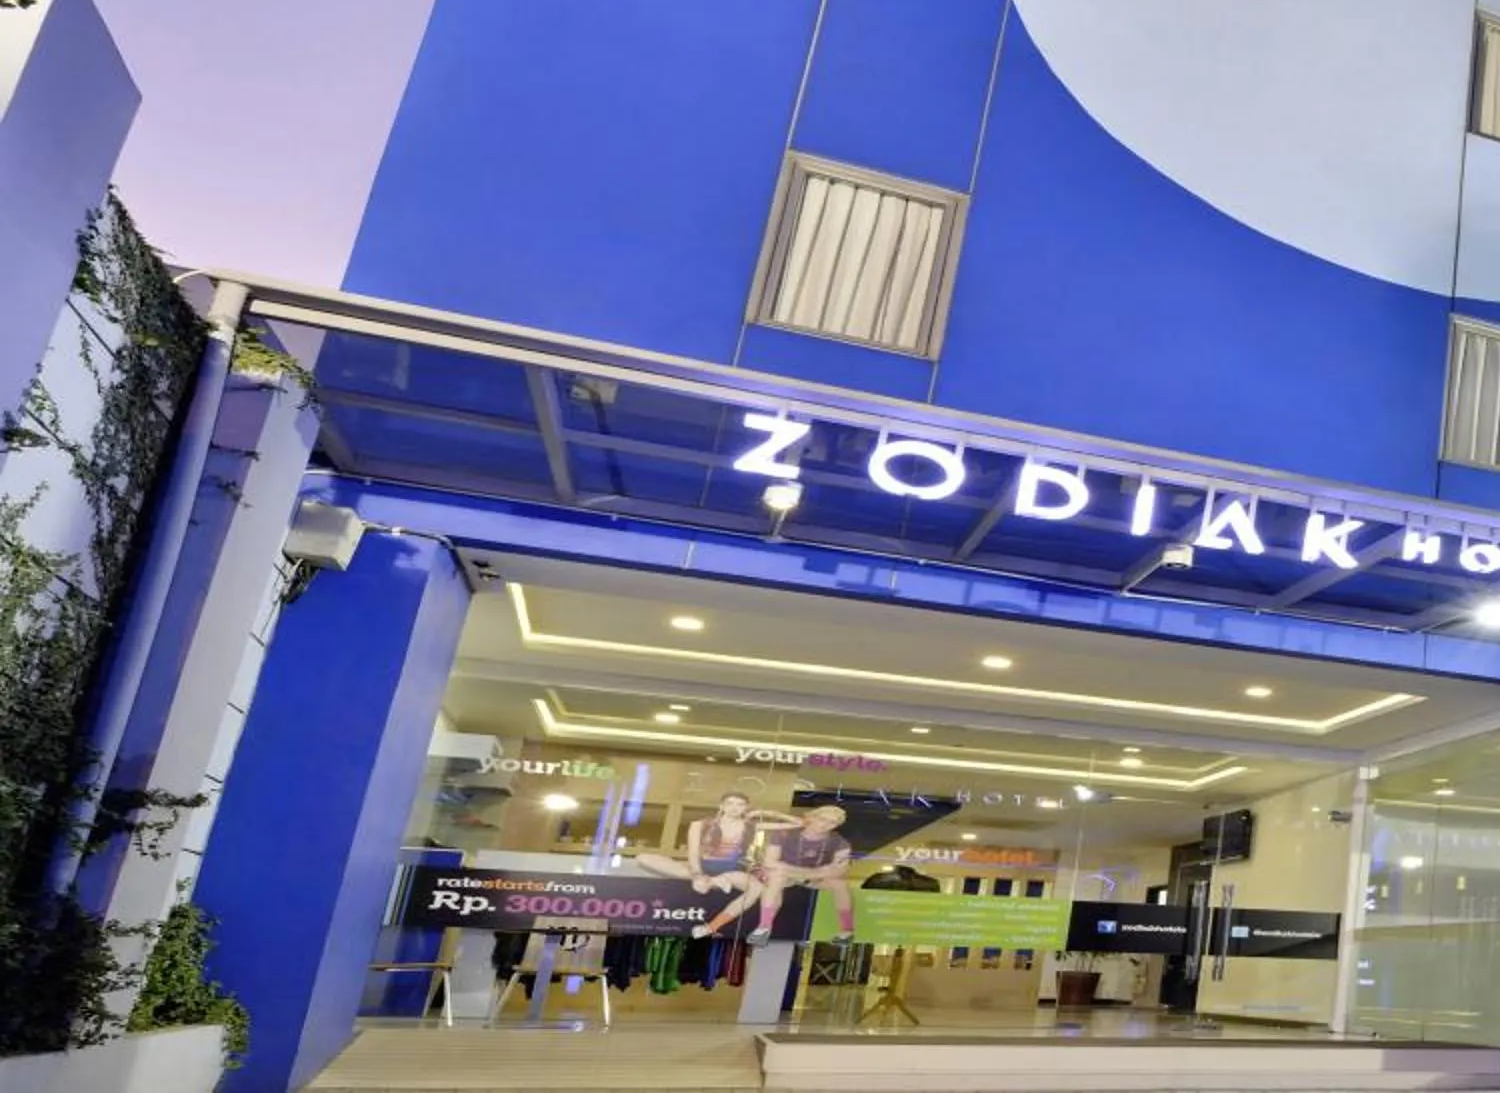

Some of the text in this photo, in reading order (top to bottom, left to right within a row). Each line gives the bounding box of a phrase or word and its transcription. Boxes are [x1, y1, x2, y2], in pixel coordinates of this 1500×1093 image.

[733, 413, 1364, 569] ZODIAK
[428, 890, 497, 916] Rp.
[652, 906, 706, 921] nett
